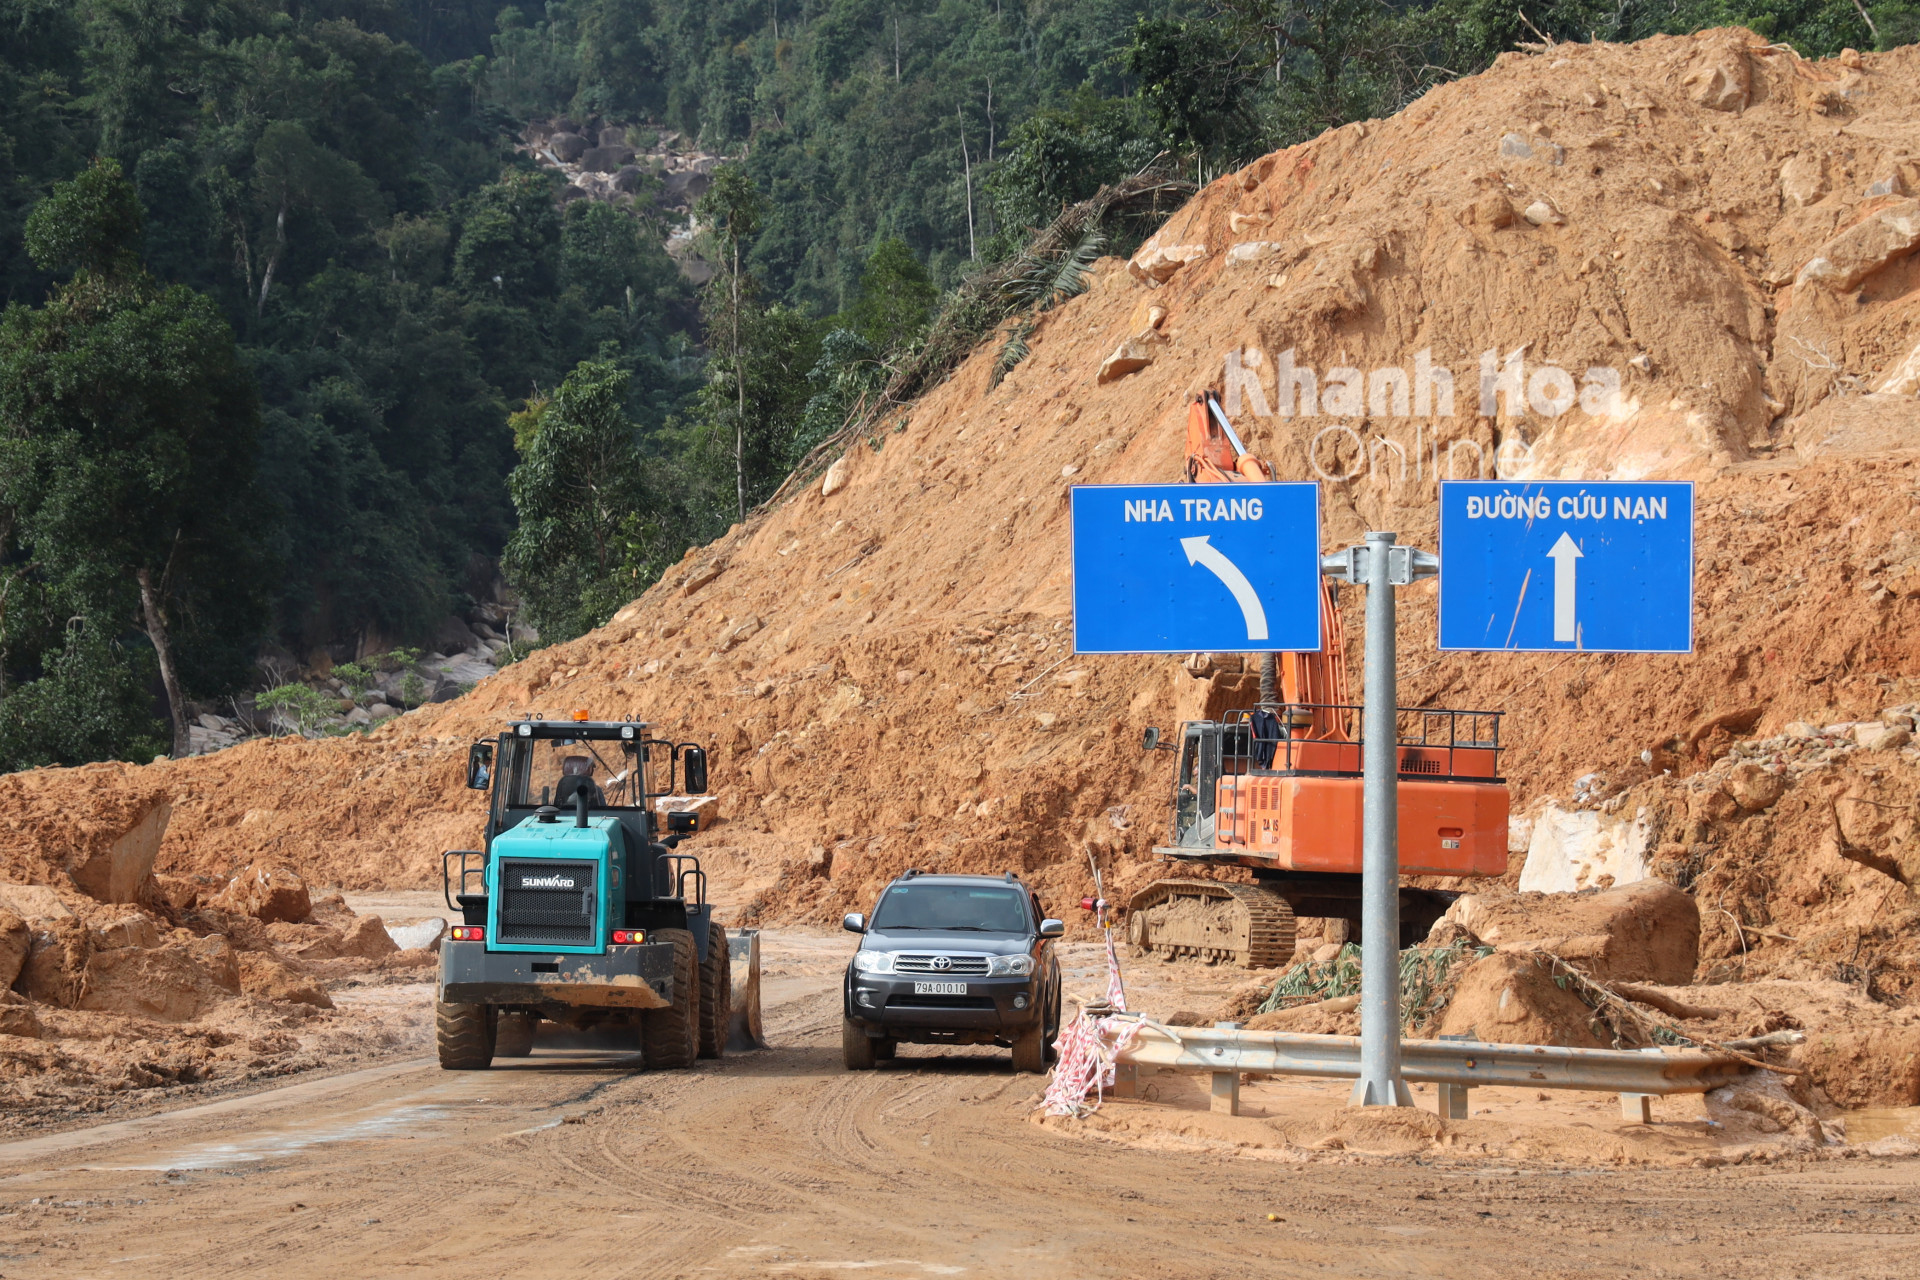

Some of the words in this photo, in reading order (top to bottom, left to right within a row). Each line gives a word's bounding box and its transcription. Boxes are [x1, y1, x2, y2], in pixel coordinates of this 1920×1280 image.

[1124, 499, 1175, 522] NHA
[1180, 498, 1263, 522] TRANG
[1466, 489, 1551, 519] ĐƯỜNG
[1557, 489, 1607, 519] CỨU
[1613, 496, 1667, 525] NẠN
[522, 874, 575, 887] SUNWARD
